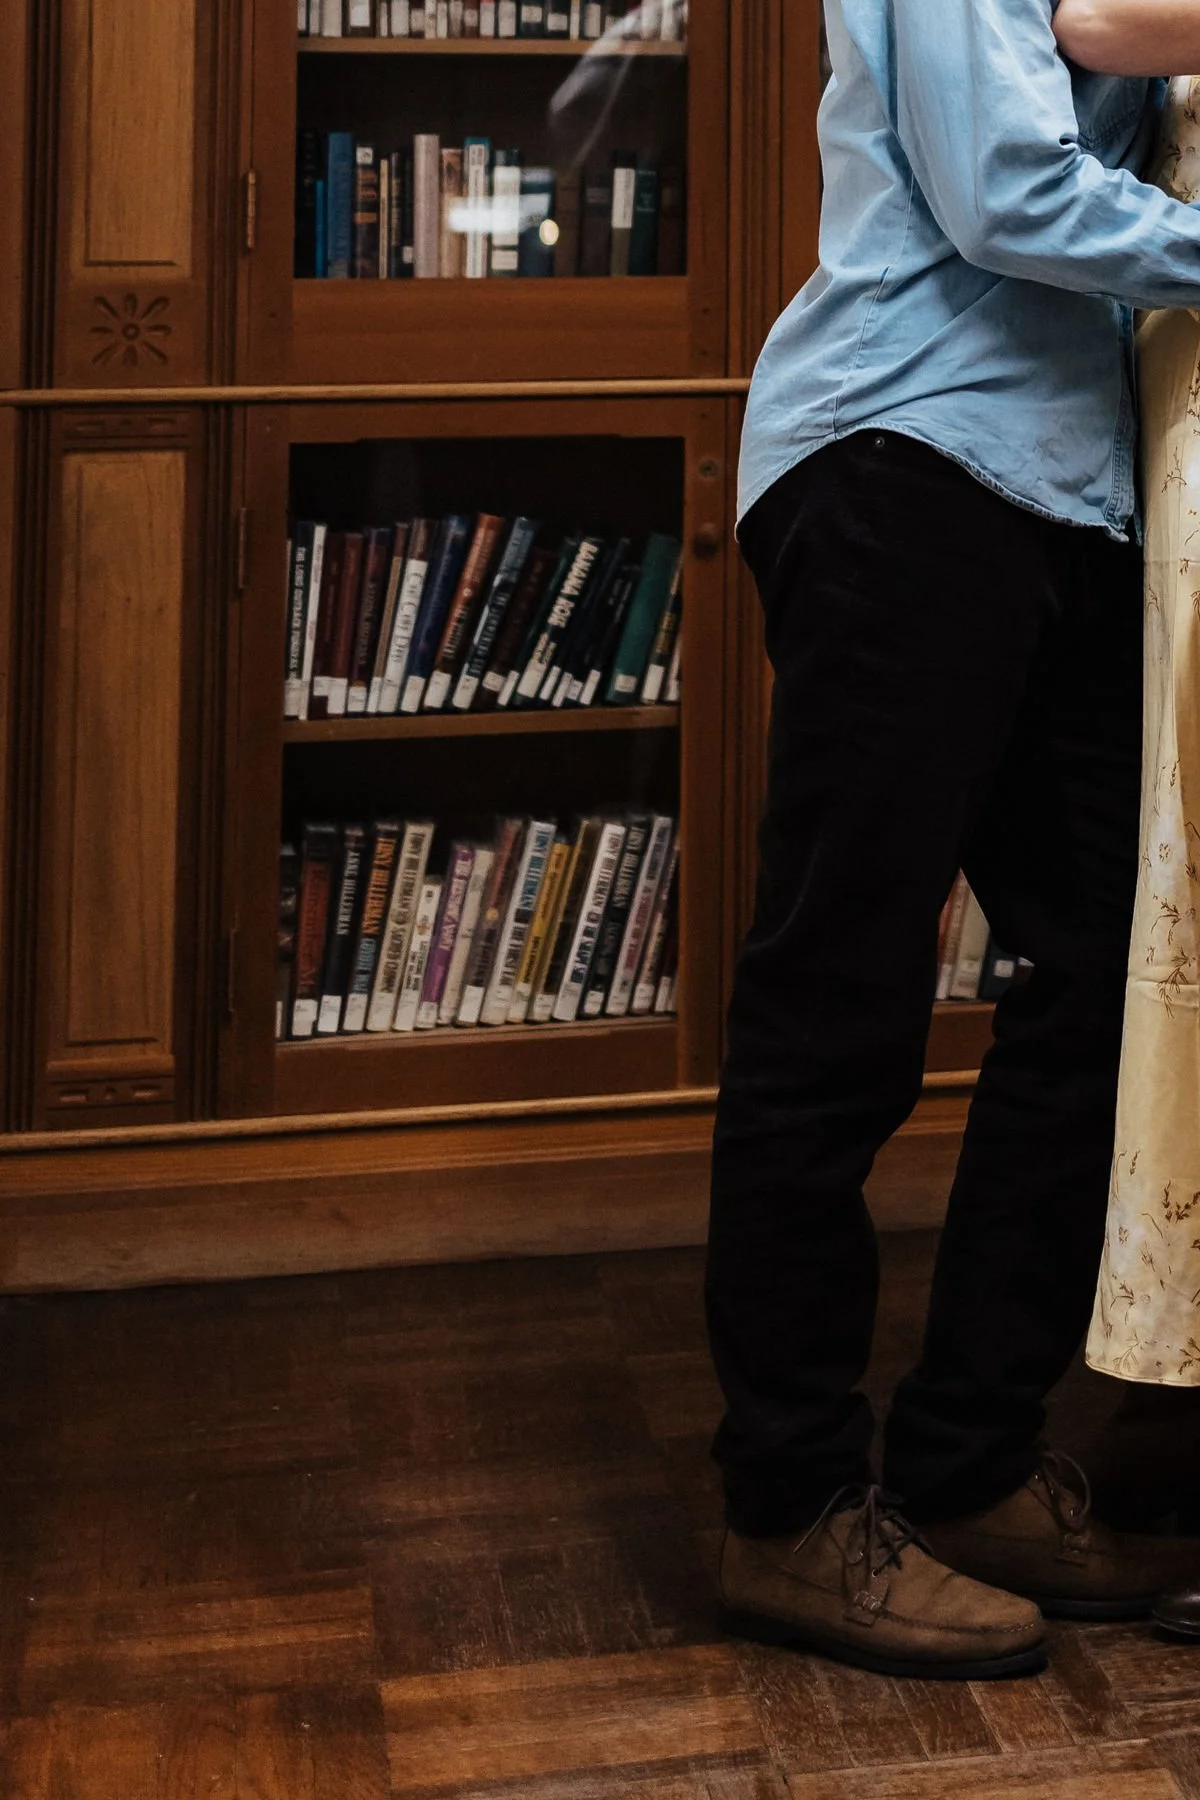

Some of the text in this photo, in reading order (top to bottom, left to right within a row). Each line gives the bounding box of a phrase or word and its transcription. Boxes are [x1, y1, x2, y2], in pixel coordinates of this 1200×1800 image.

[545, 540, 601, 630] BANANA ROSE
[335, 849, 361, 936] ANNE HILLERMAN
[360, 835, 398, 936] TONY HILLERMAN
